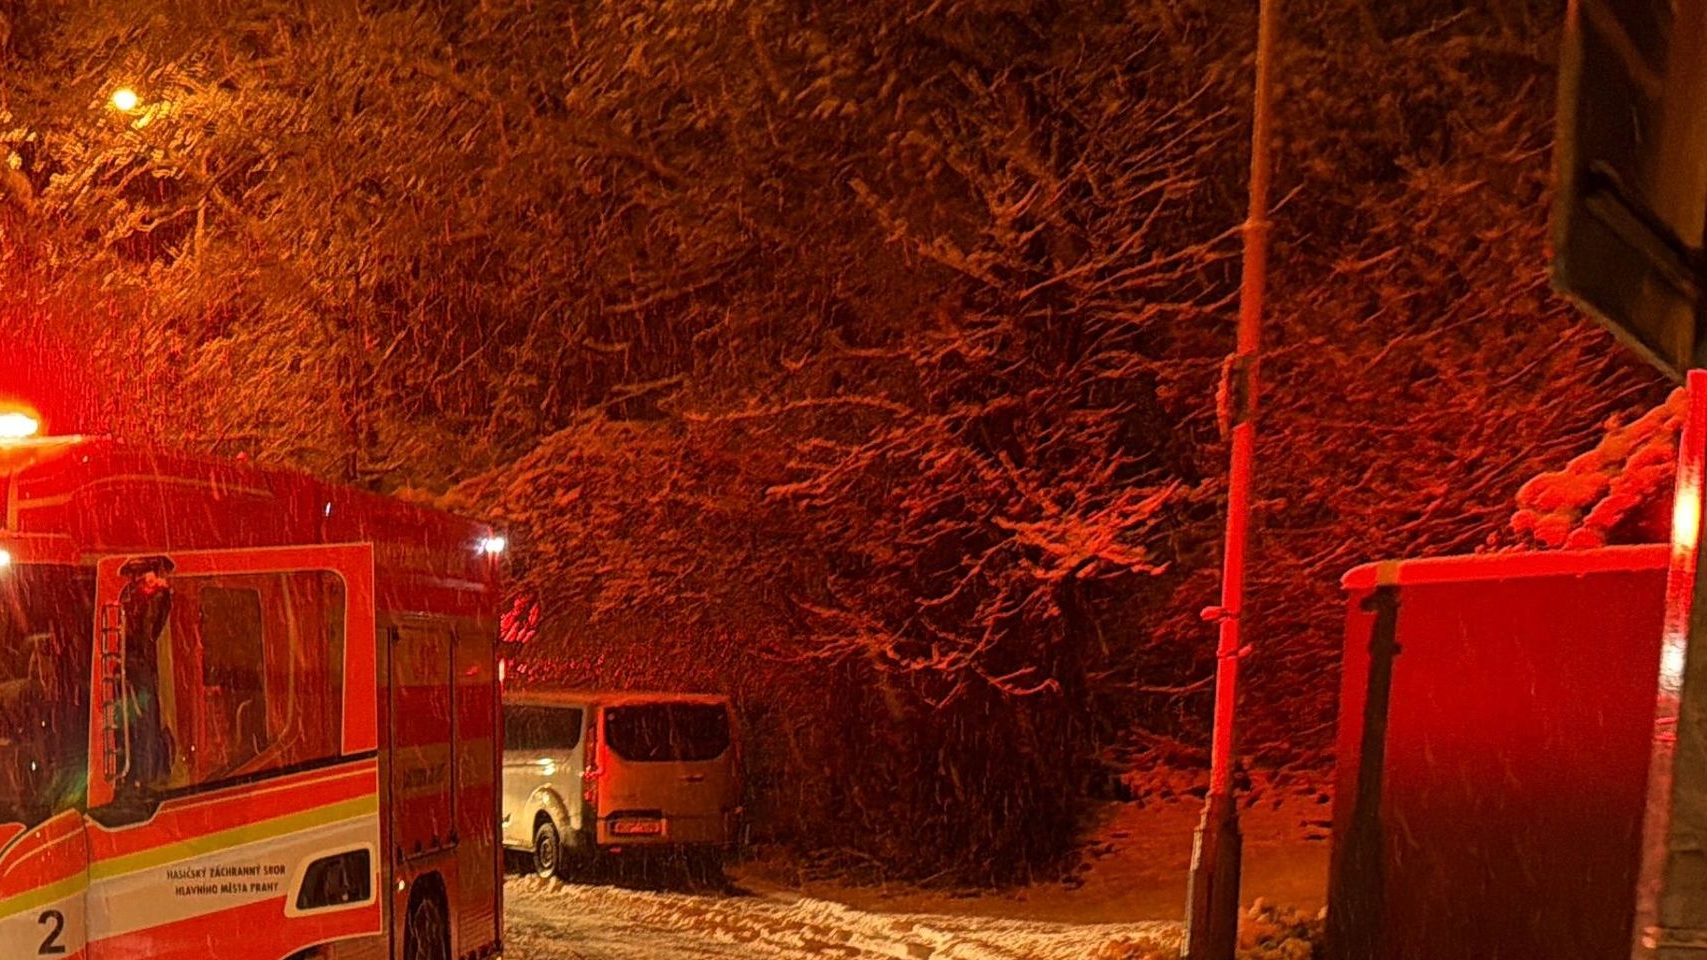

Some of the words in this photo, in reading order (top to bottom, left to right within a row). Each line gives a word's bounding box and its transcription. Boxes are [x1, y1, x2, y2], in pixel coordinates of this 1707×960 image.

[175, 882, 218, 896] HLAVNÍHO
[250, 882, 278, 894] PRAHY
[37, 909, 66, 956] 2
